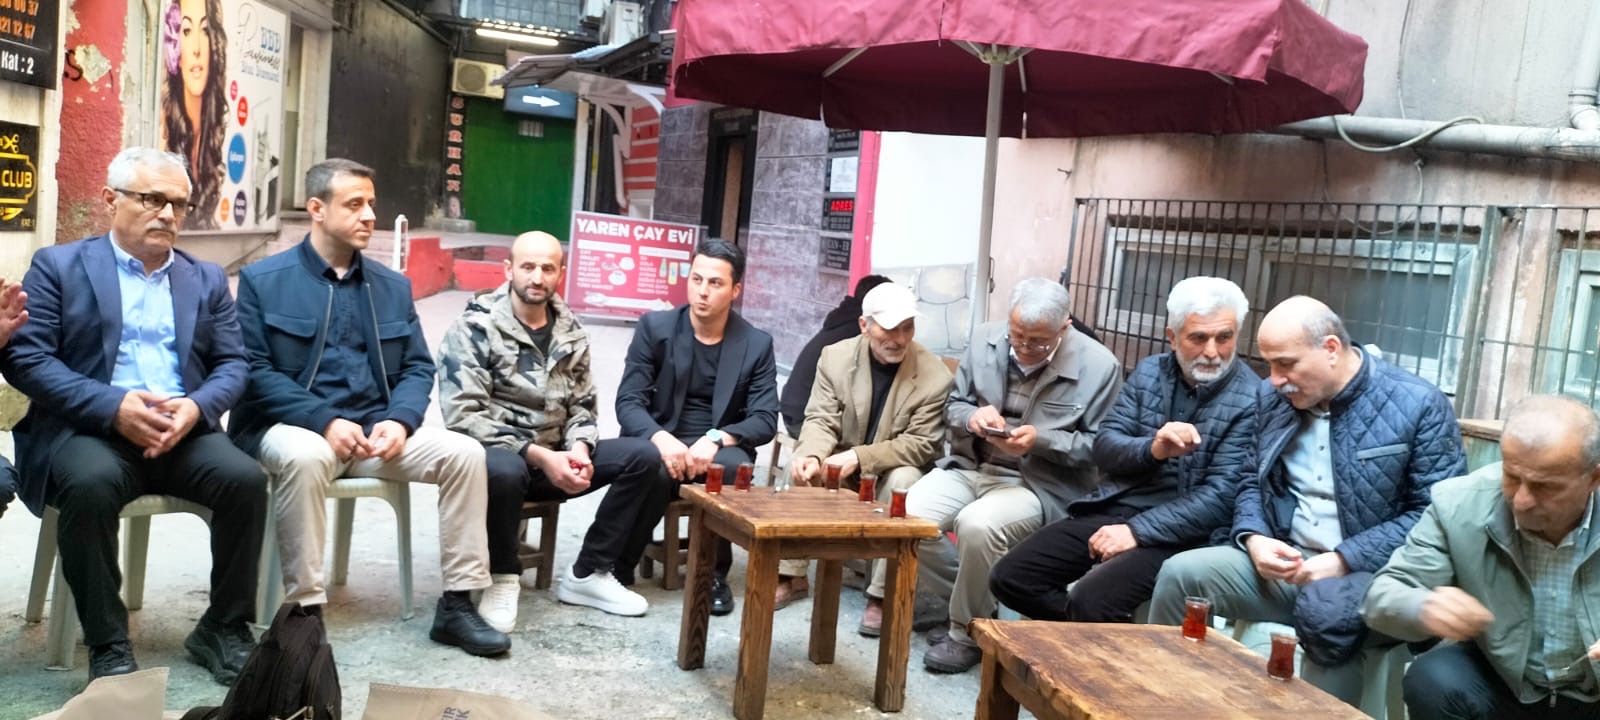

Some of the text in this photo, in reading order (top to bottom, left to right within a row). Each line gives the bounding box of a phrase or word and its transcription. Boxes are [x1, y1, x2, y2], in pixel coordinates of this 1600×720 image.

[1, 50, 19, 72] Kat
[26, 56, 34, 75] 2
[2, 169, 32, 188] CLUB
[830, 199, 853, 212] ADRES
[576, 217, 694, 245] YAREN ÇAY EVİ
